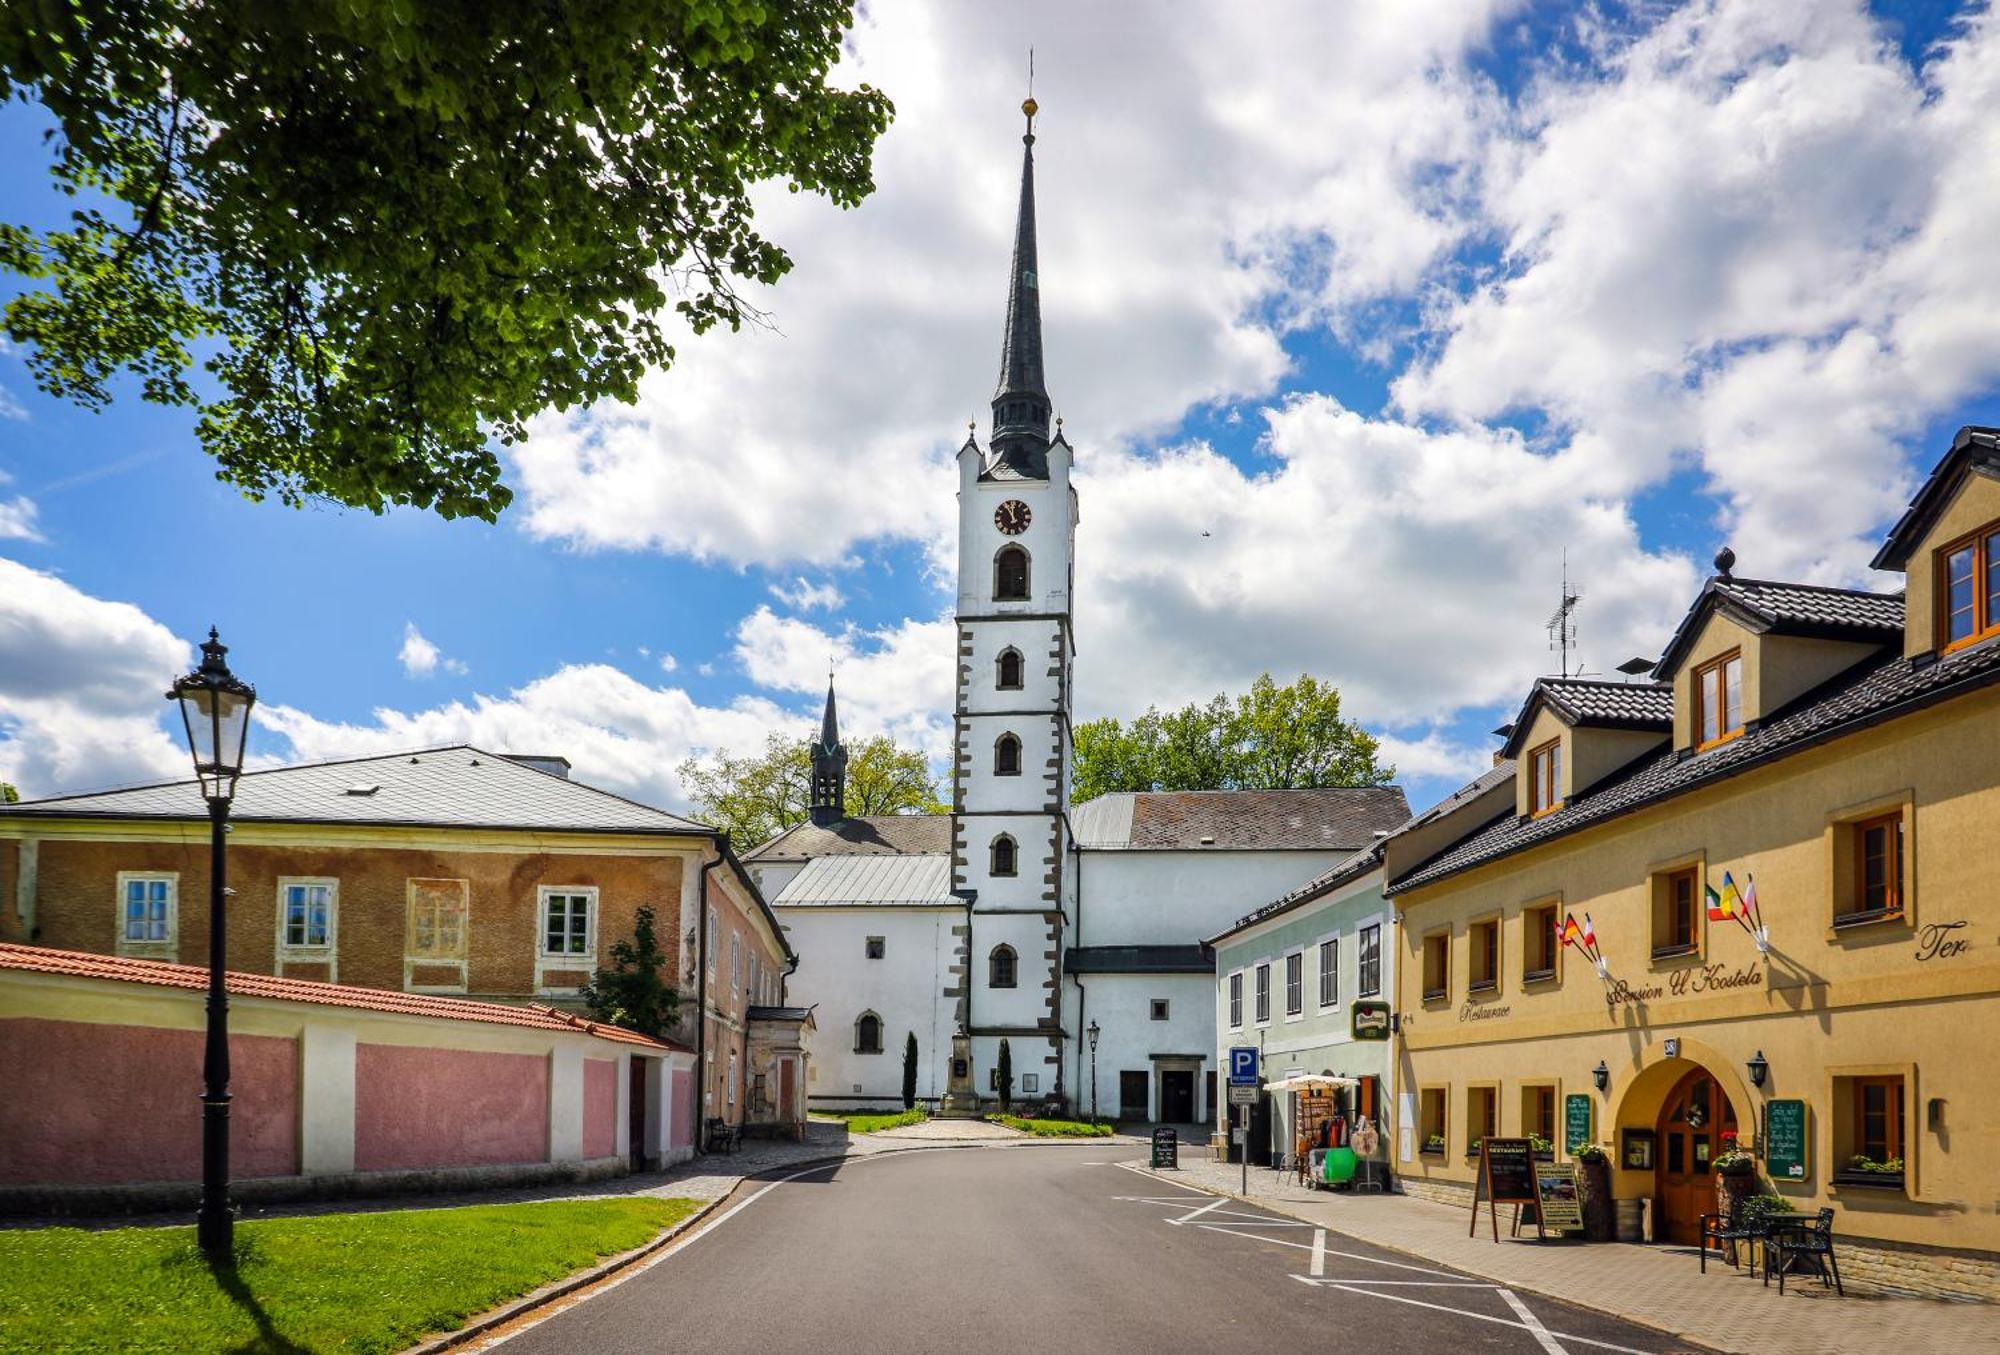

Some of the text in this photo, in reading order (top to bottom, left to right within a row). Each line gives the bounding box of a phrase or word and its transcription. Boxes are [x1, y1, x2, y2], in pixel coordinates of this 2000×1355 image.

[1606, 962, 1762, 1005] Pension U Kostela
[1460, 1000, 1511, 1022] Restaurace
[1236, 1052, 1252, 1074] P
